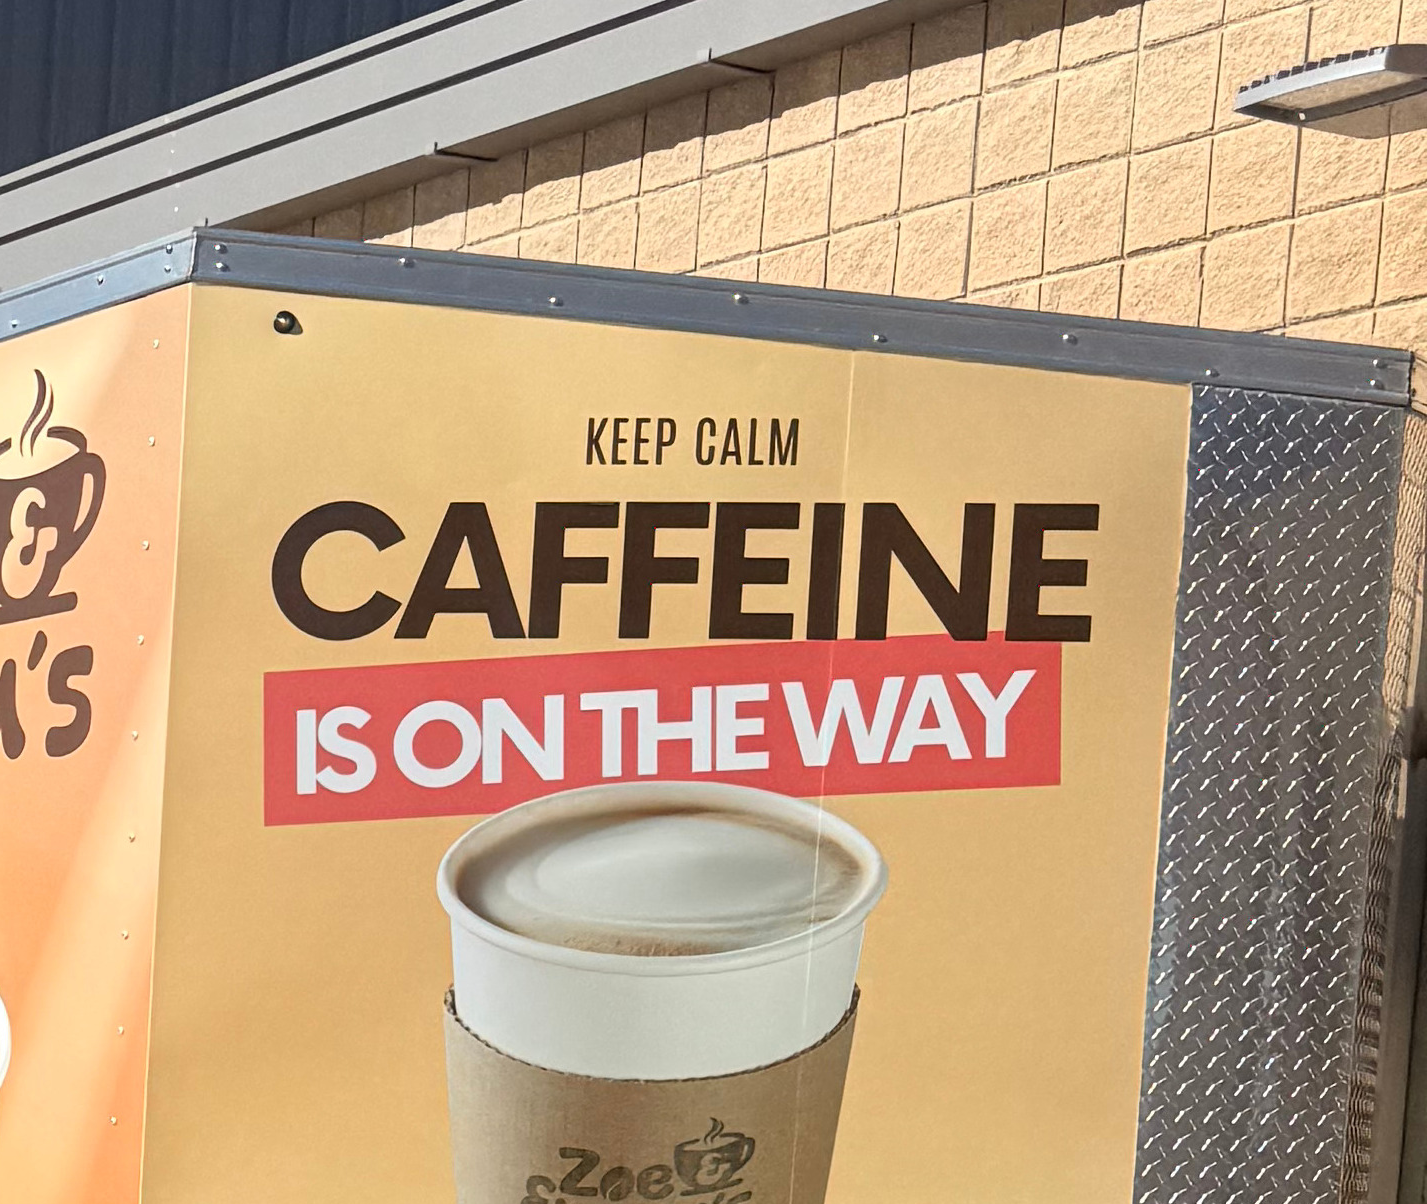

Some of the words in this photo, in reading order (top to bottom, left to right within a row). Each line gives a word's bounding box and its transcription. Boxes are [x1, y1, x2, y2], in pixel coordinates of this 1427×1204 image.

[586, 417, 677, 467] KEEP
[695, 417, 801, 467] CALM
[271, 500, 1101, 643] CAFFEINE
[296, 706, 378, 796] IS
[393, 694, 565, 788] ON
[579, 682, 769, 778] THE
[780, 668, 1038, 768] WAY
[558, 1146, 675, 1202] Zoe
